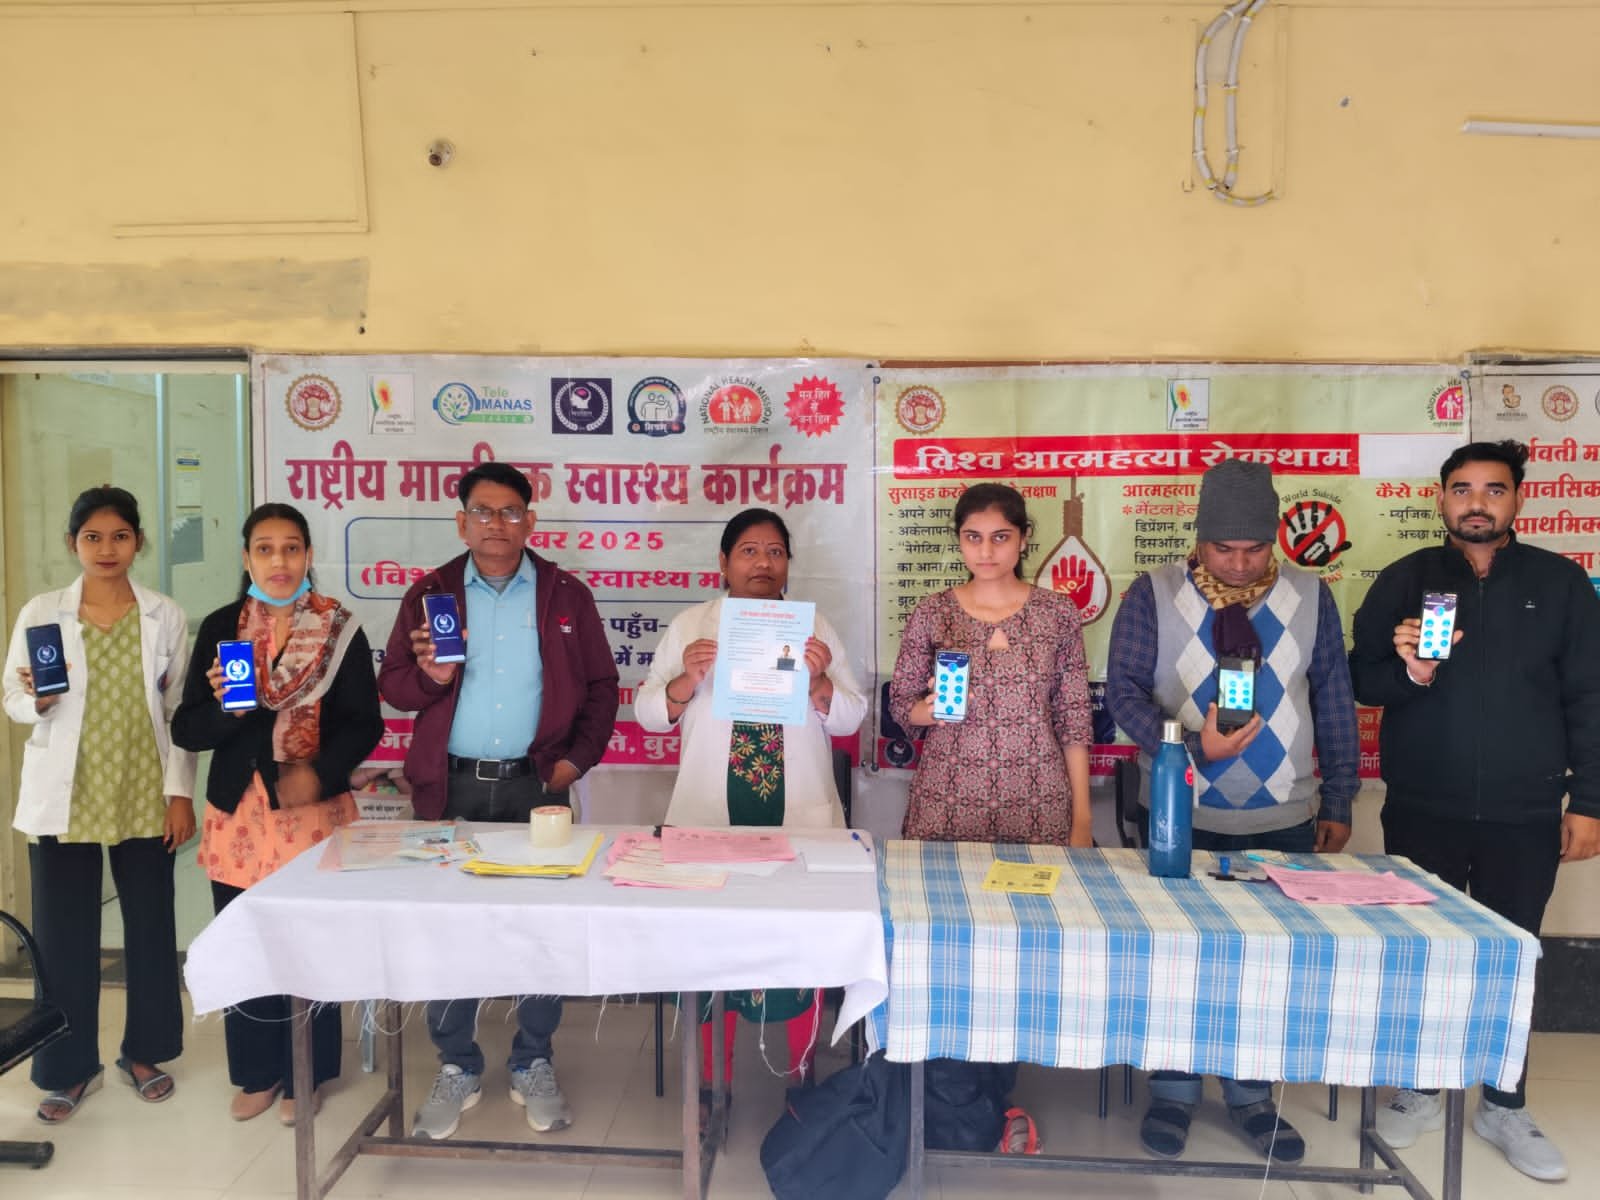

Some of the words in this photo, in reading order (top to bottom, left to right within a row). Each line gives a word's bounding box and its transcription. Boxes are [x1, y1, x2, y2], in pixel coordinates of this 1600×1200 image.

[481, 386, 508, 398] Tele
[481, 399, 532, 410] MANAS
[915, 445, 1004, 471] विश्व
[1013, 449, 1193, 471] आत्महत्या
[286, 440, 387, 510] राष्ट्रीय
[564, 462, 690, 505] स्वास्थ्य
[701, 443, 847, 510] कार्यक्रम
[888, 486, 934, 504] सुसाइड
[1122, 484, 1196, 497] आत्महत्या
[1281, 489, 1309, 504] World
[1312, 488, 1343, 505] Suicide
[1375, 482, 1411, 498] कैसे
[898, 505, 924, 518] अपने
[929, 509, 952, 518] आप
[1135, 501, 1173, 515] मेंटल
[578, 531, 665, 550] 2025
[1398, 529, 1429, 540] अच्छा
[897, 563, 912, 572] का
[586, 570, 691, 589] स्वास्थ्य
[614, 645, 632, 665] में
